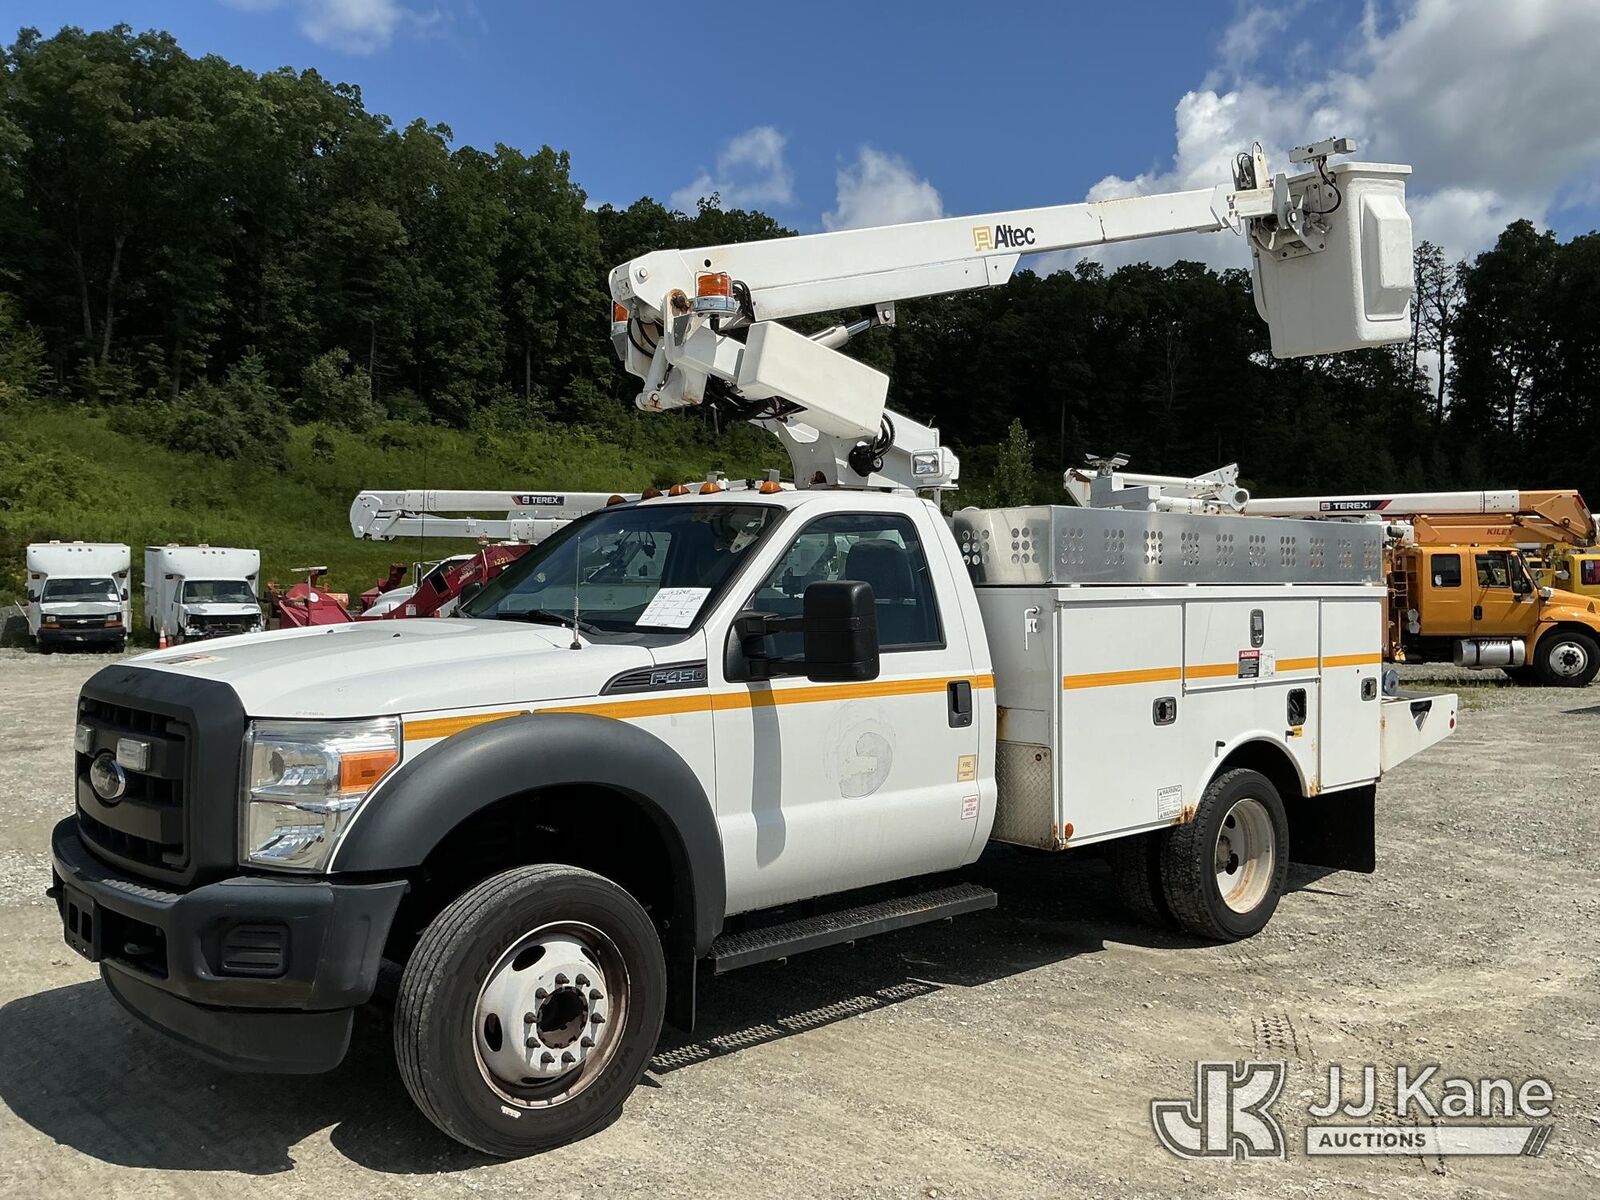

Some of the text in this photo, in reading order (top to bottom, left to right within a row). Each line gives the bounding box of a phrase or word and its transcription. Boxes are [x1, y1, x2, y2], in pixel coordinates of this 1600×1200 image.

[994, 224, 1036, 249] Altec
[531, 496, 559, 504] TEREX
[1332, 501, 1368, 510] TEREX
[1486, 527, 1514, 536] KILEY
